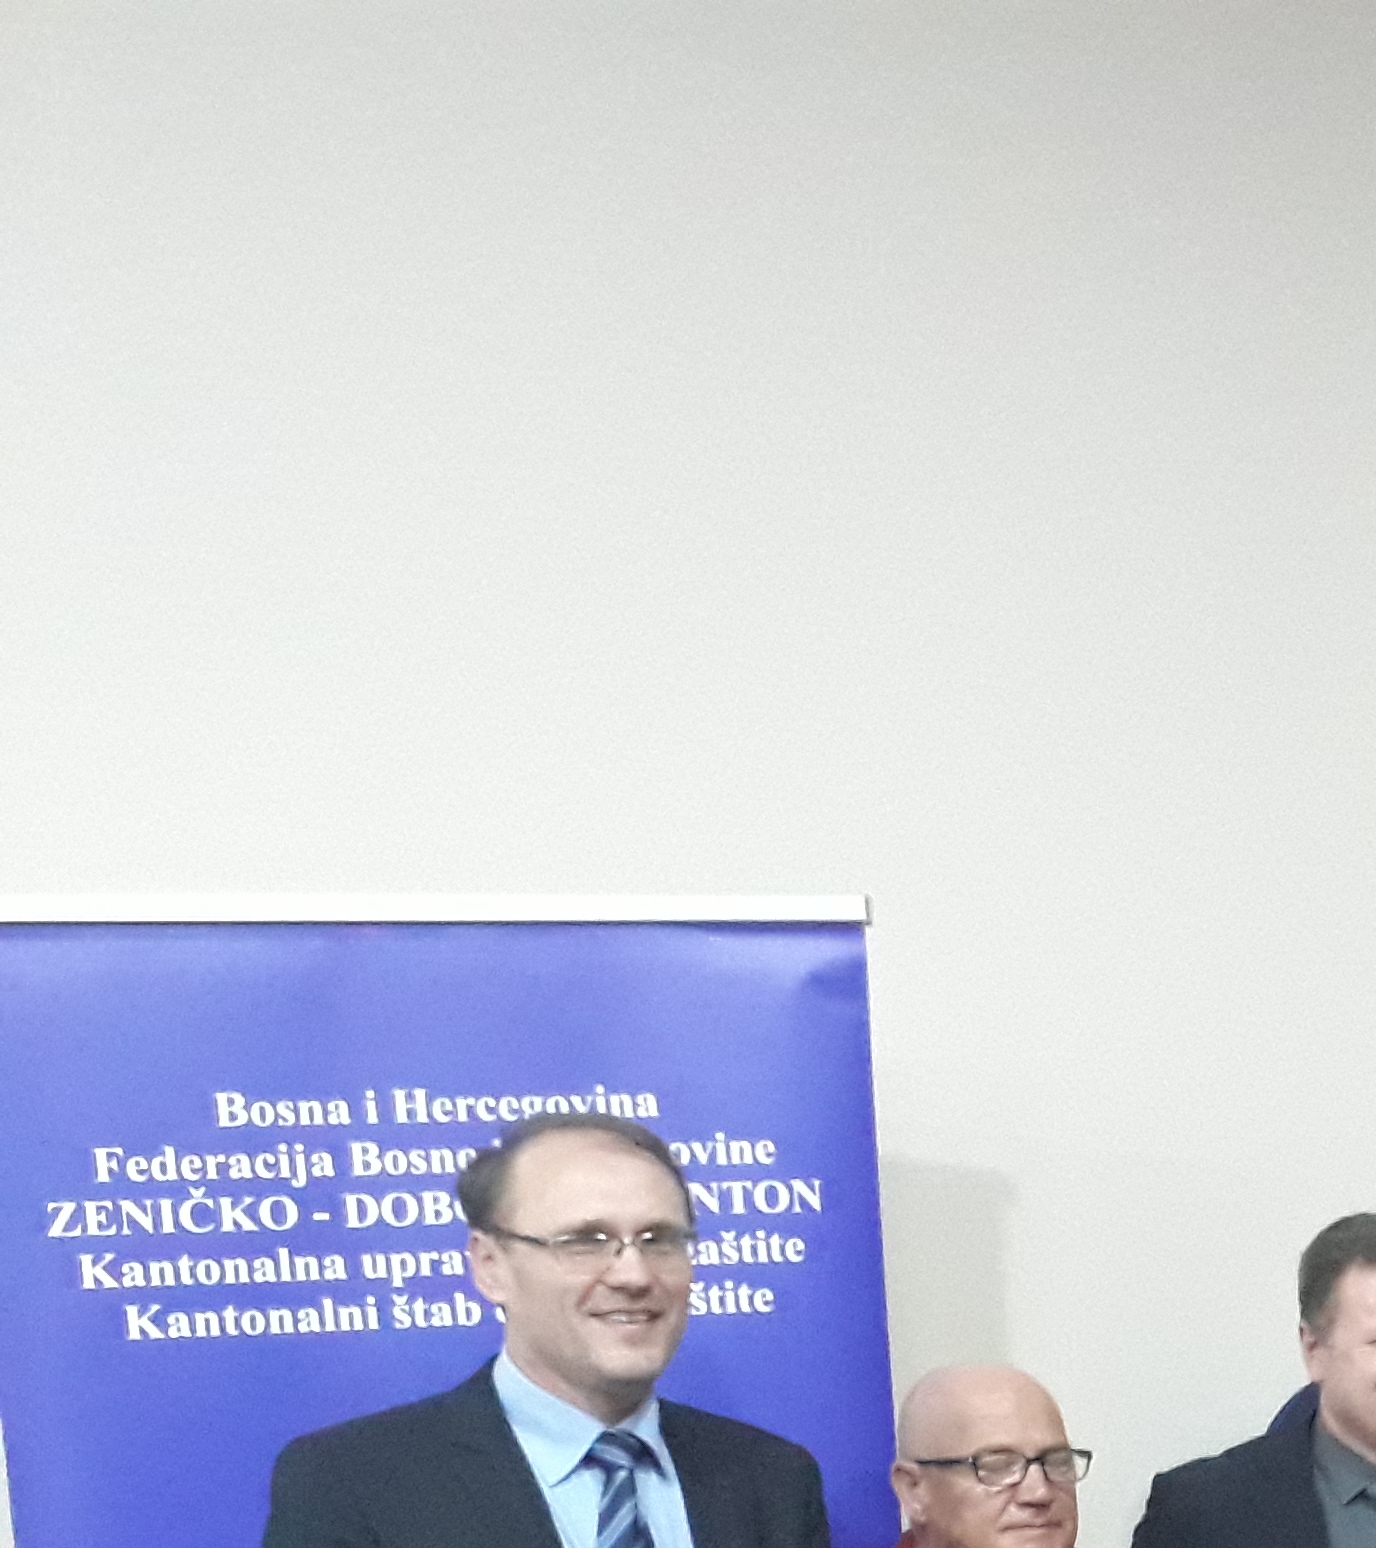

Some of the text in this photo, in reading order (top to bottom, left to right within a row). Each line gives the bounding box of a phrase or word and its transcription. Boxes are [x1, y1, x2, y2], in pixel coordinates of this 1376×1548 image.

[214, 1084, 660, 1128] Bosna i Hercegovina
[93, 1145, 336, 1188] Federacija
[46, 1186, 299, 1239] ZENIČKO
[312, 1210, 331, 1222] -
[78, 1247, 348, 1290] Kantonalna
[362, 1246, 470, 1288] upra
[124, 1296, 380, 1341] Kantonalni
[392, 1292, 483, 1330] štab
